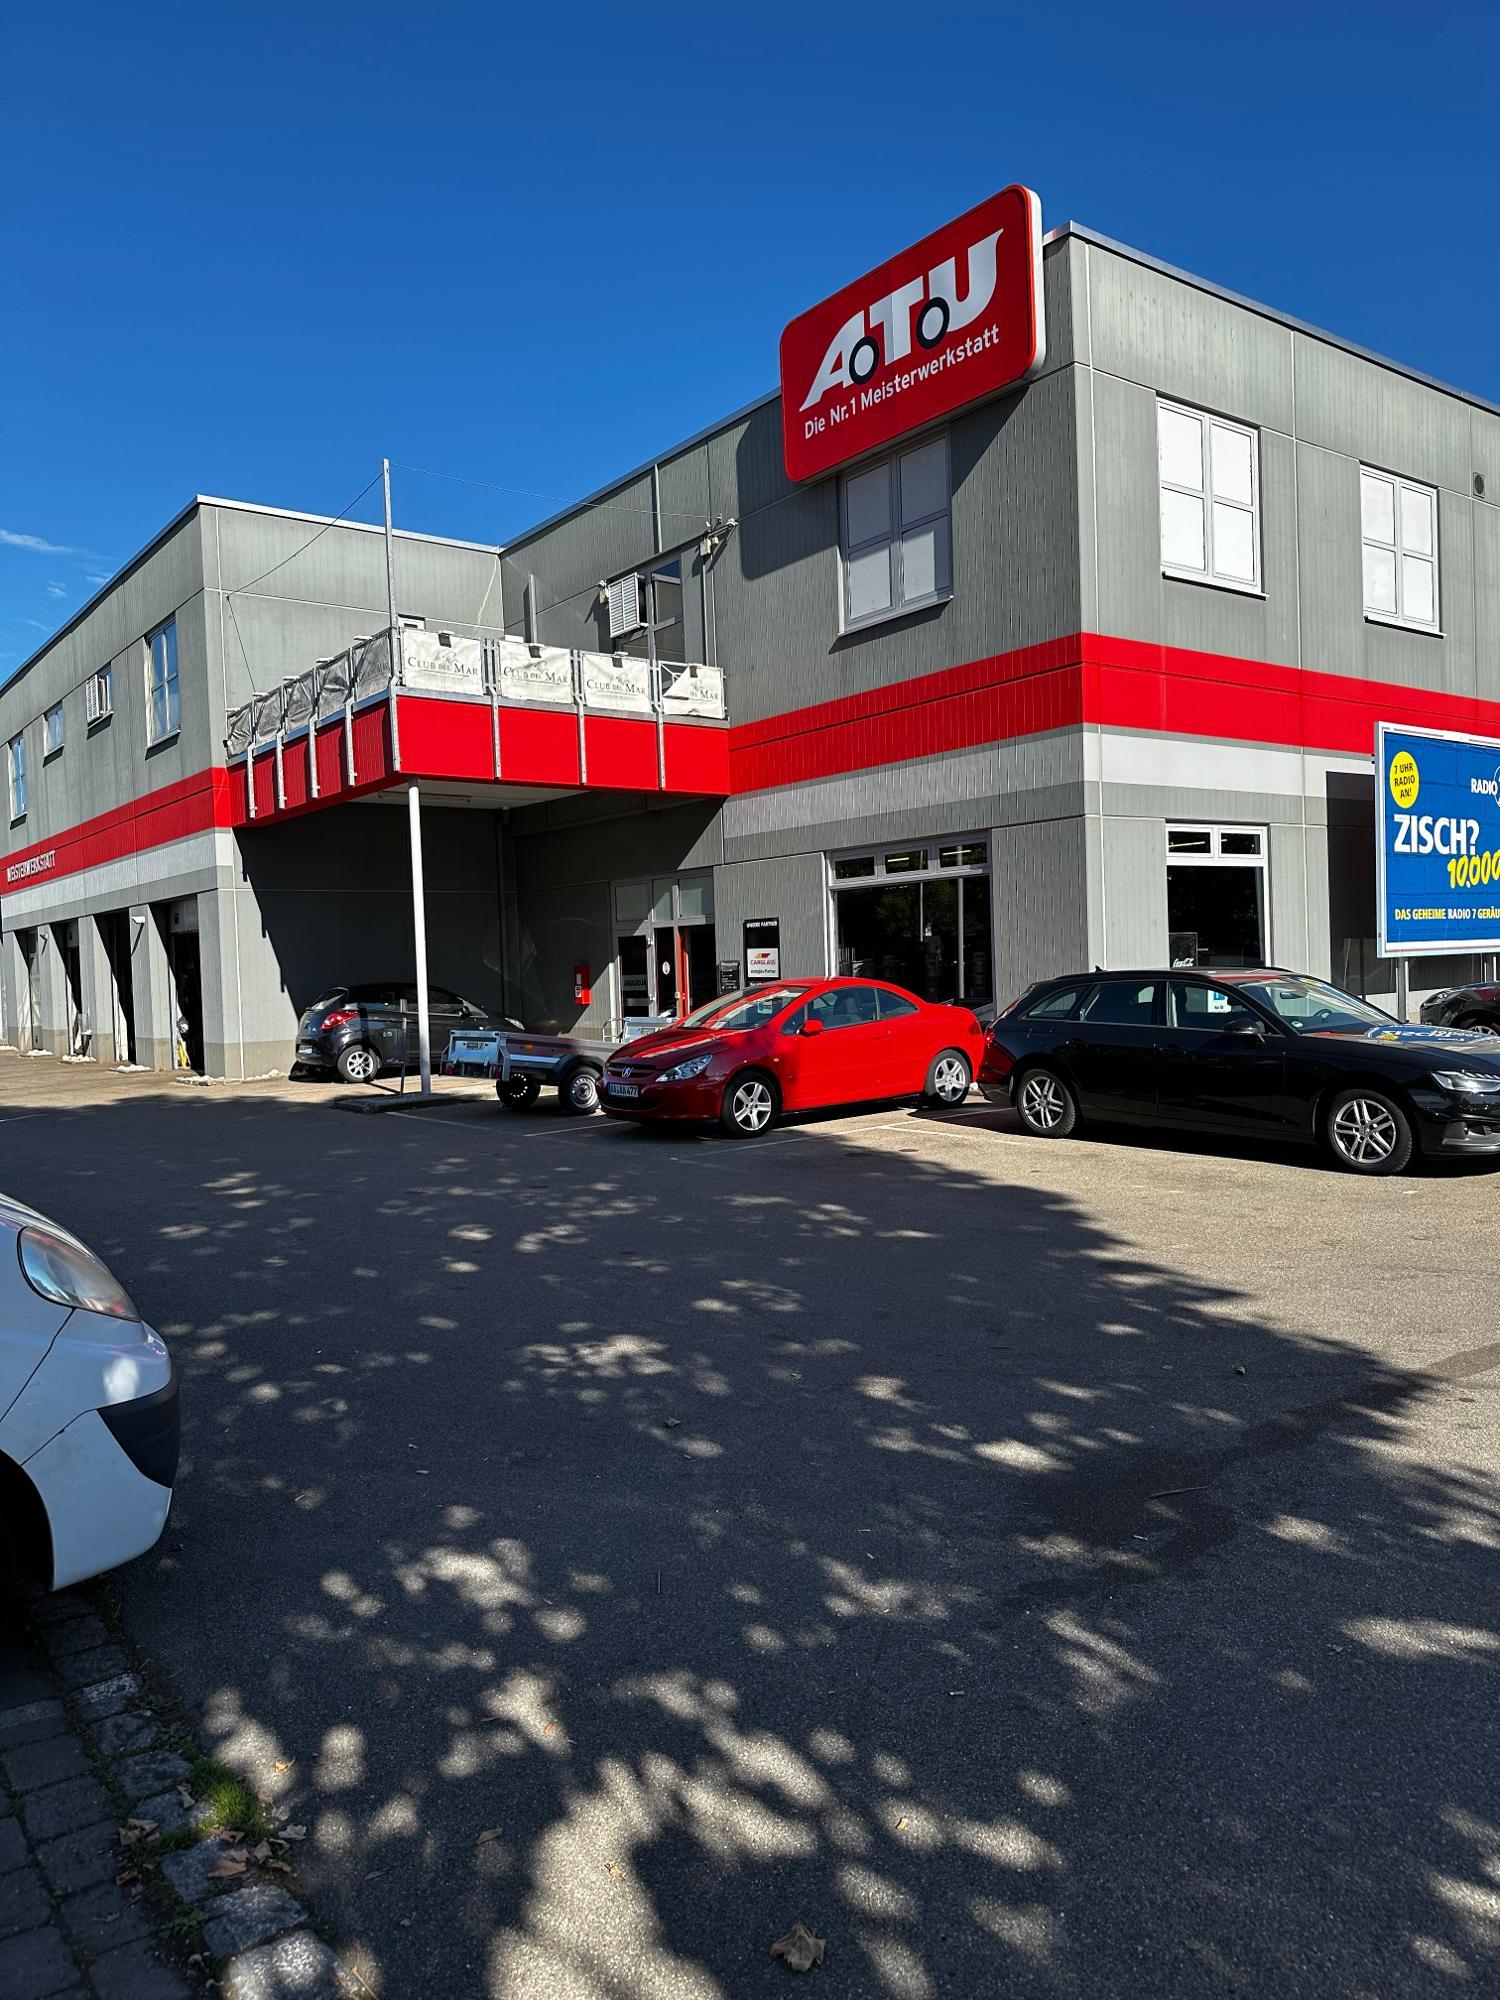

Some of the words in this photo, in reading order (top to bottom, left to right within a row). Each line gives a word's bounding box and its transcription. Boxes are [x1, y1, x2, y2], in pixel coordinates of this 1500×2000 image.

[804, 416, 826, 440] Die
[860, 323, 1000, 411] Meisterwerkstatt
[1393, 765, 1398, 774] 7
[1399, 762, 1414, 774] UHR
[1394, 774, 1416, 787] RADIO
[1470, 777, 1499, 796] RADIO
[1400, 787, 1412, 800] AN!
[1393, 813, 1480, 856] ZISCH?
[1394, 908, 1412, 920] DAS
[1412, 908, 1447, 920] GEHEIME
[1447, 908, 1471, 920] RADIO
[1471, 908, 1477, 920] 7
